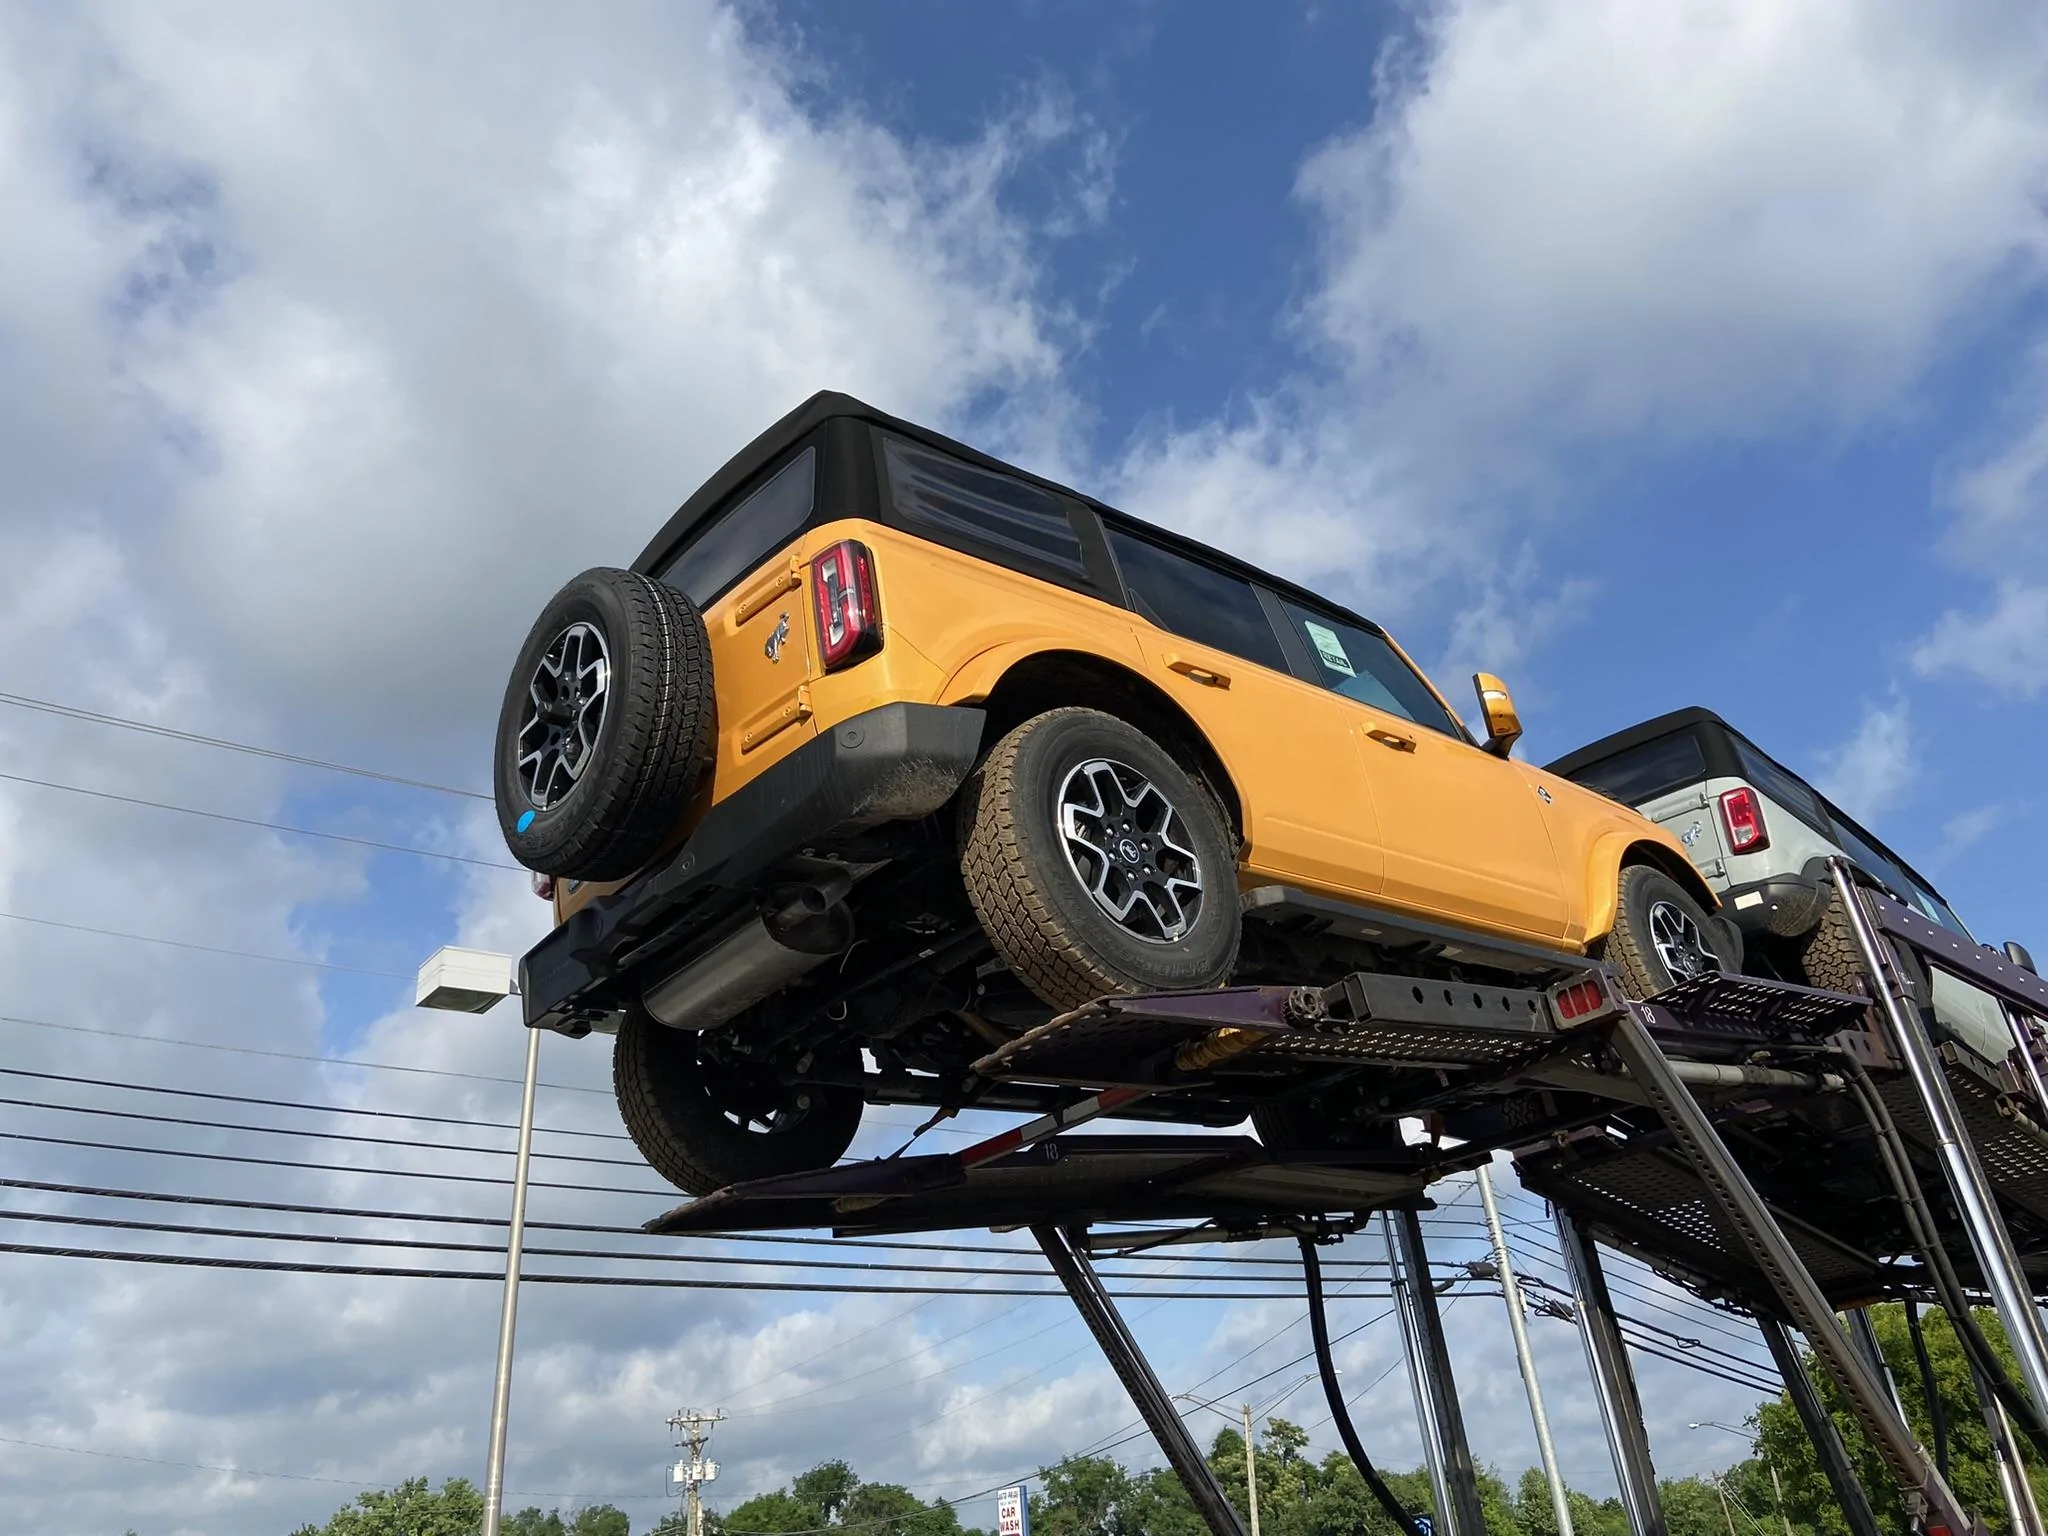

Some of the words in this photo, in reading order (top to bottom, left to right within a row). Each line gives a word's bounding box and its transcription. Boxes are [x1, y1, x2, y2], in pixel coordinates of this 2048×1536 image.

[1640, 1005, 1656, 1024] 18
[1043, 1143, 1059, 1160] 18
[1001, 1507, 1016, 1519] CAR
[1000, 1519, 1020, 1533] WASH
